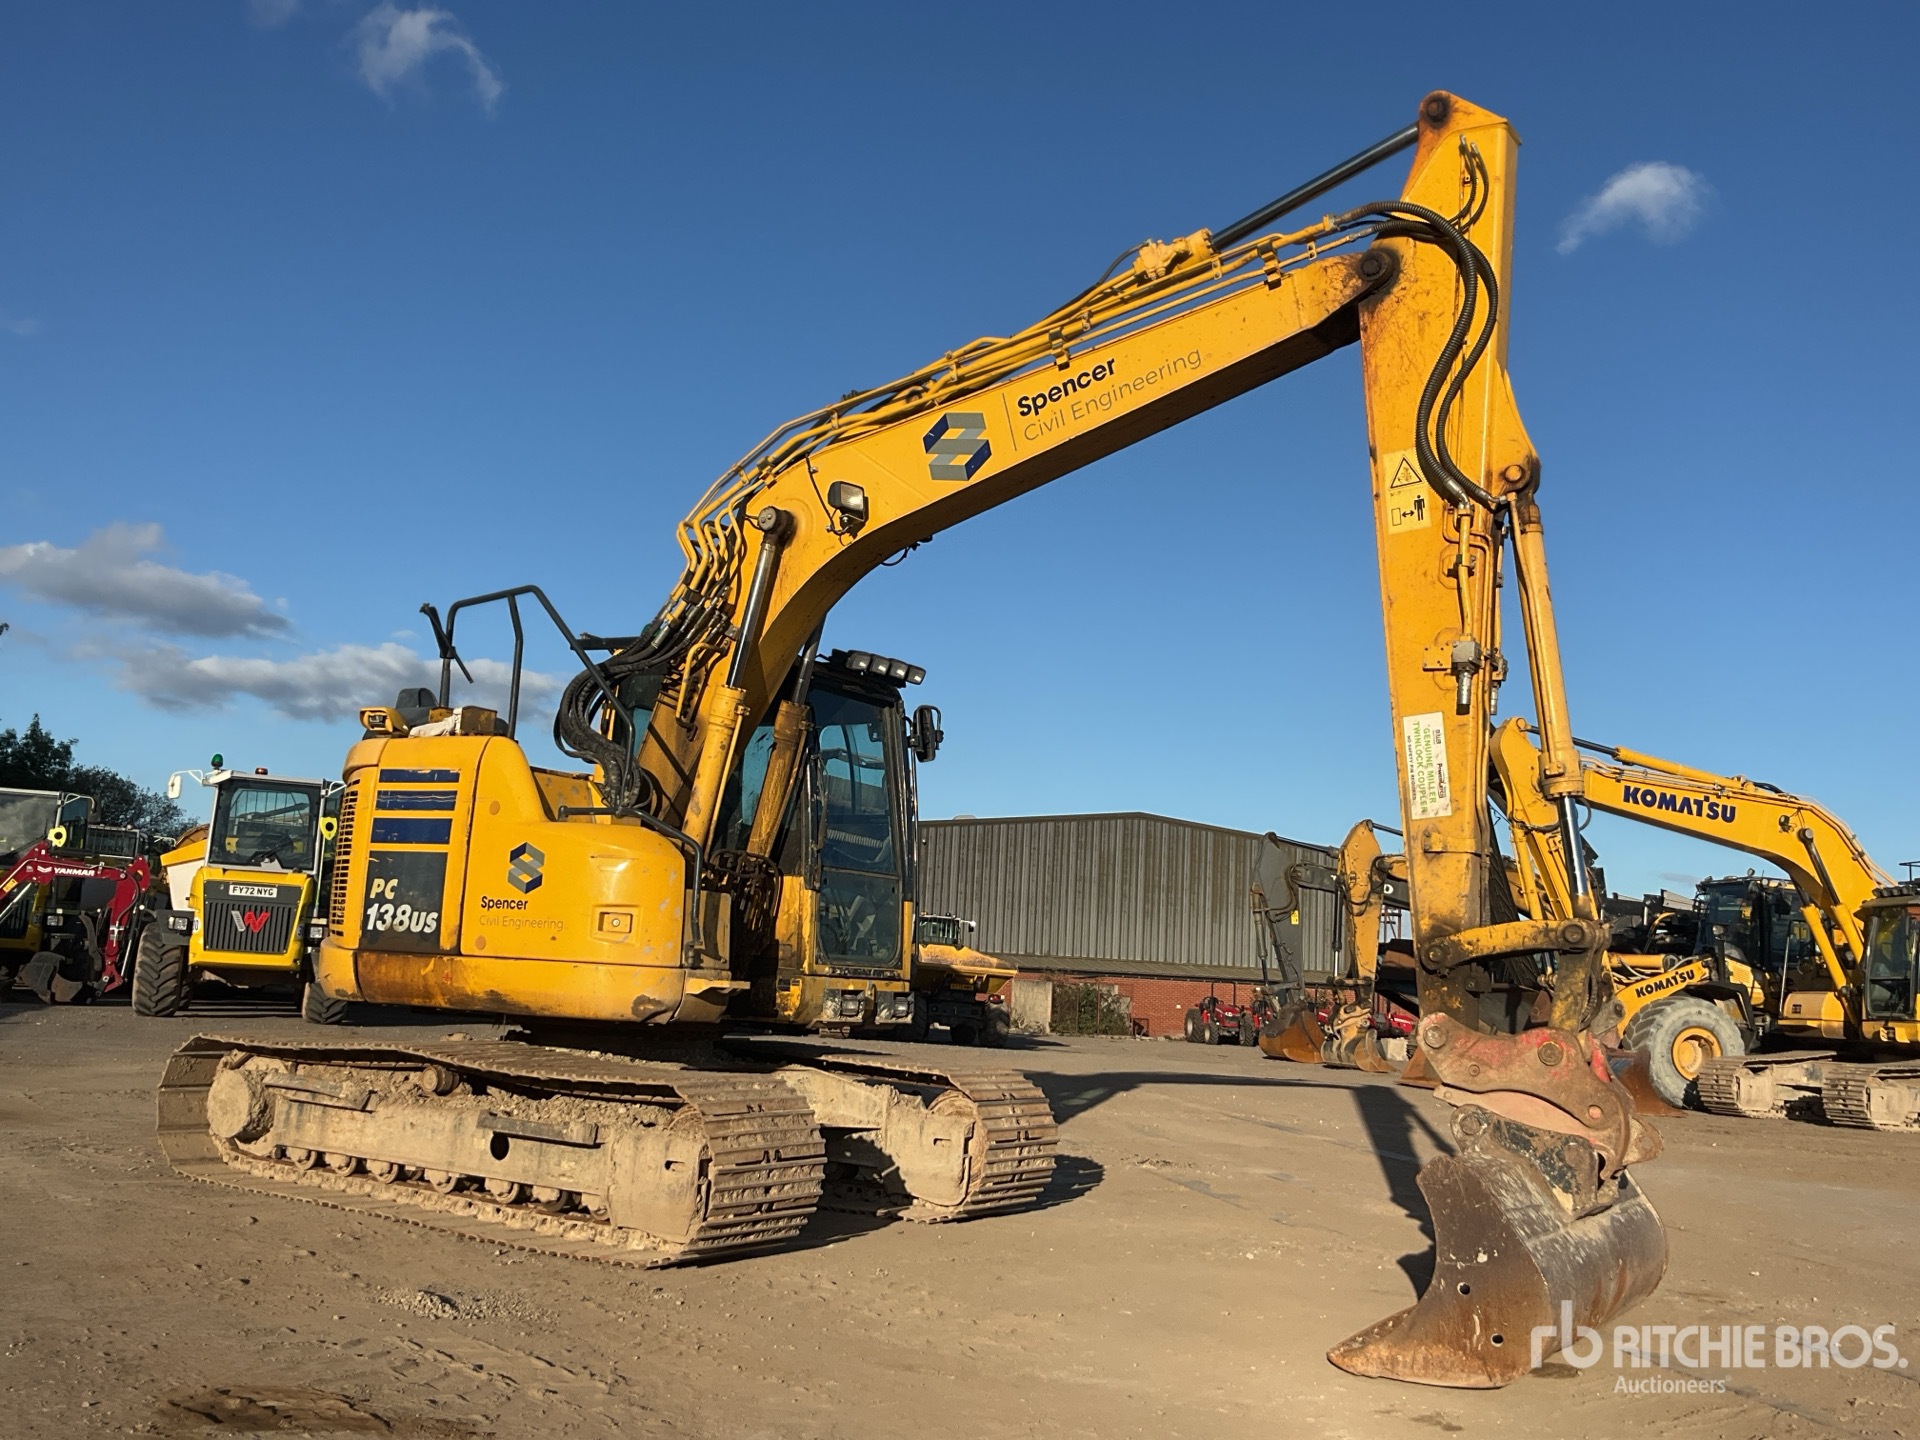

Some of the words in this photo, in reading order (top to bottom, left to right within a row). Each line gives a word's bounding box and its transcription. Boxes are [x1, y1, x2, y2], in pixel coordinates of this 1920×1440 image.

[1017, 357, 1115, 417] Spencer
[1024, 410, 1065, 441] Civil
[1071, 348, 1202, 421] Engineering
[1412, 721, 1424, 767] TWINLOCK
[1423, 728, 1433, 767] GENUINE
[1417, 771, 1428, 813] COUPLER
[1426, 770, 1437, 803] MILLER
[1622, 785, 1736, 823] KOMATSU
[54, 867, 95, 877] YANMAR
[232, 886, 255, 895] FY72
[257, 887, 274, 896] NYG
[369, 878, 399, 900] PC
[481, 896, 529, 911] Spencer
[479, 915, 499, 926] Civil
[502, 916, 564, 931] Engineering
[1635, 969, 1695, 999] KOMATSU
